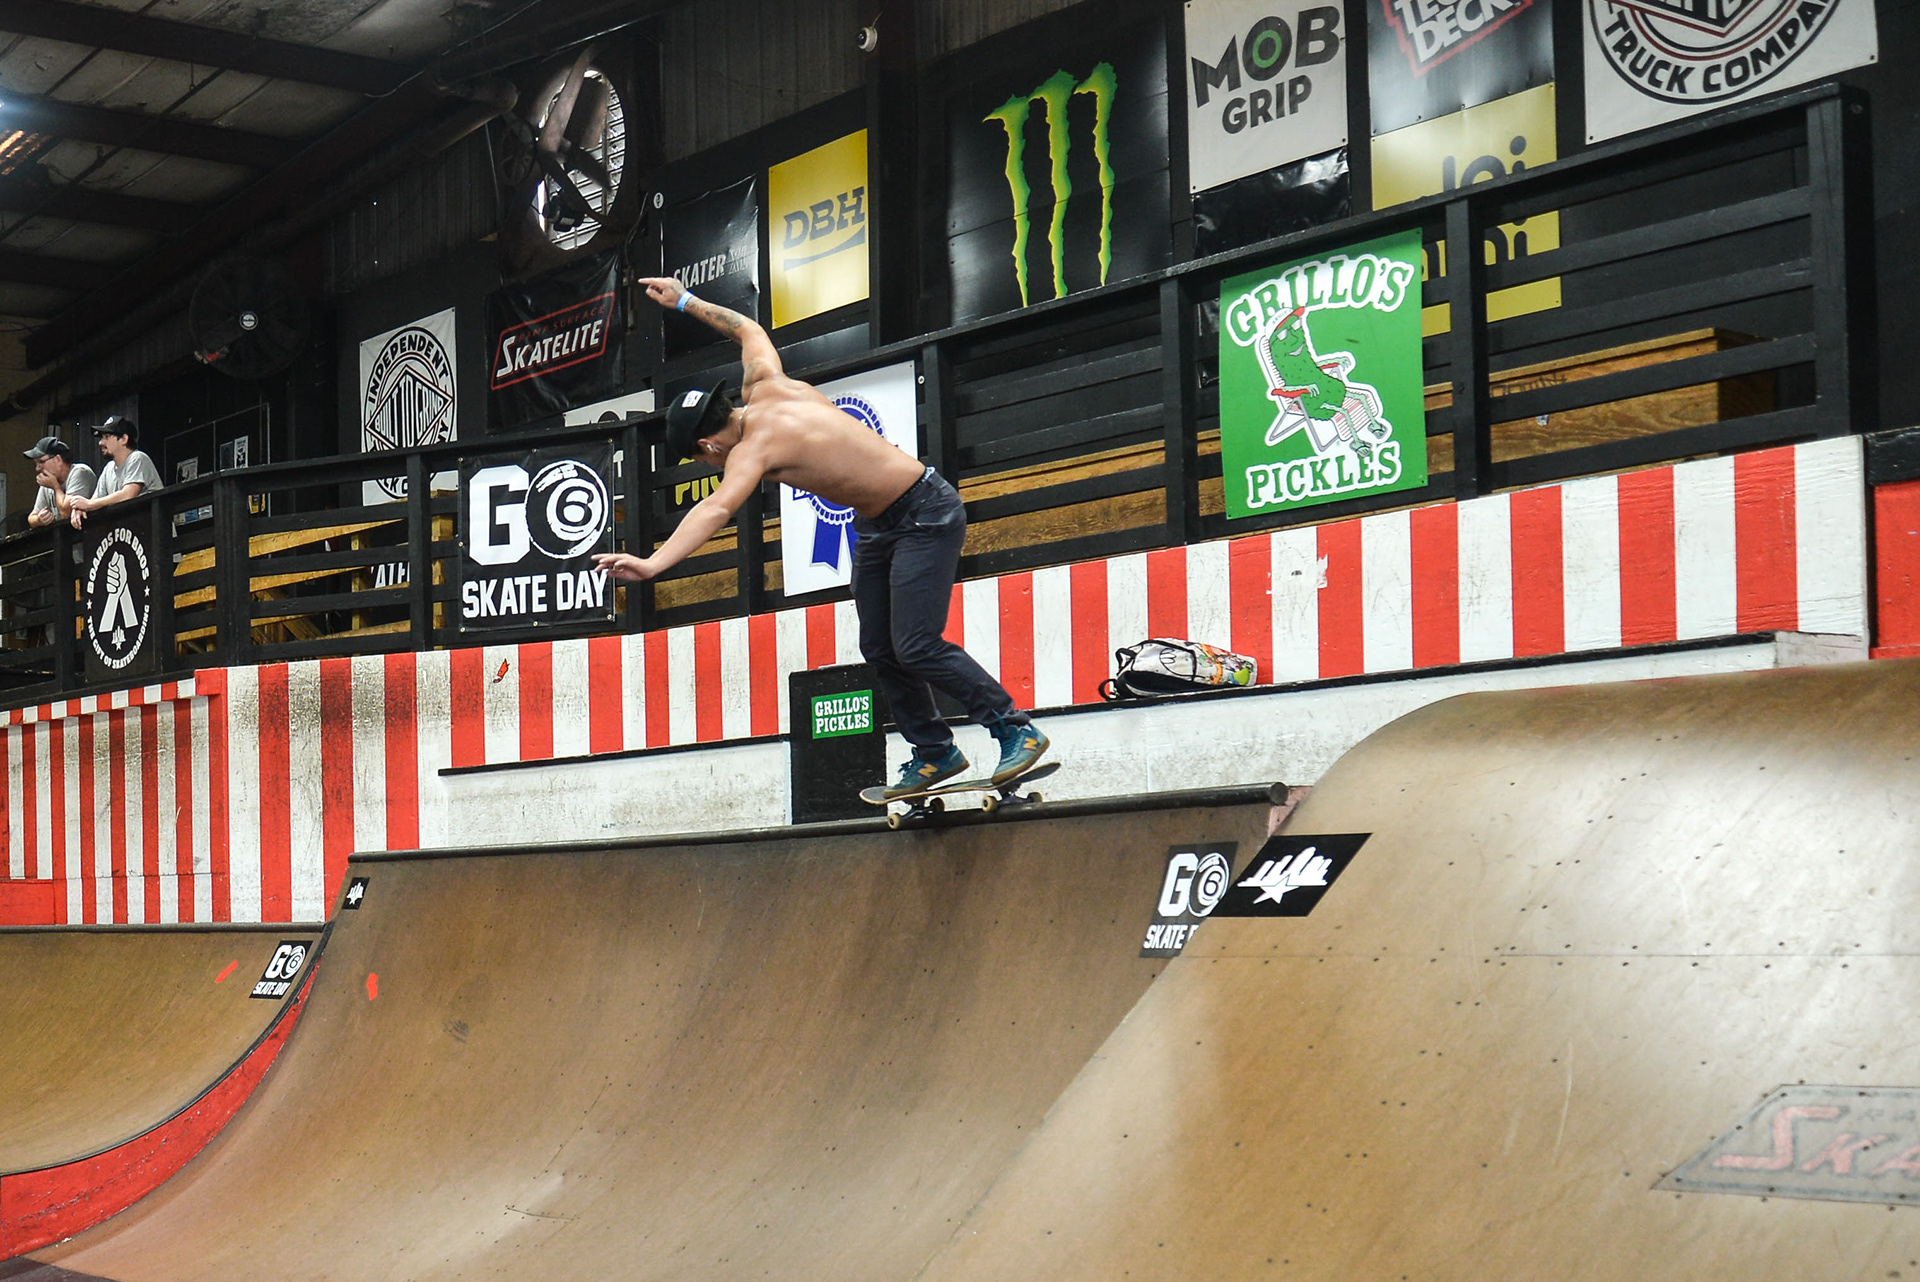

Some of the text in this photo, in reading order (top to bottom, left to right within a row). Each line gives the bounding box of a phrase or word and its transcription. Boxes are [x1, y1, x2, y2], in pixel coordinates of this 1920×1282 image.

[1191, 5, 1341, 108] MOB
[1605, 0, 1837, 94] TRUCK COMPA
[1222, 74, 1313, 134] GRIP
[783, 185, 865, 249] DBH
[1228, 256, 1412, 344] GRILLO'S
[368, 334, 450, 404] INDEPENDENT
[496, 319, 603, 379] SKATELITE
[1248, 444, 1399, 505] PICKLES
[87, 527, 150, 595] BOARDS FOR BROS
[462, 574, 548, 619] SKATE
[556, 569, 609, 611] DAY
[112, 604, 150, 670] SKATEBOARDING
[815, 695, 870, 717] GRILLO'S
[815, 712, 870, 734] PICKLES
[1143, 924, 1188, 949] SKATE
